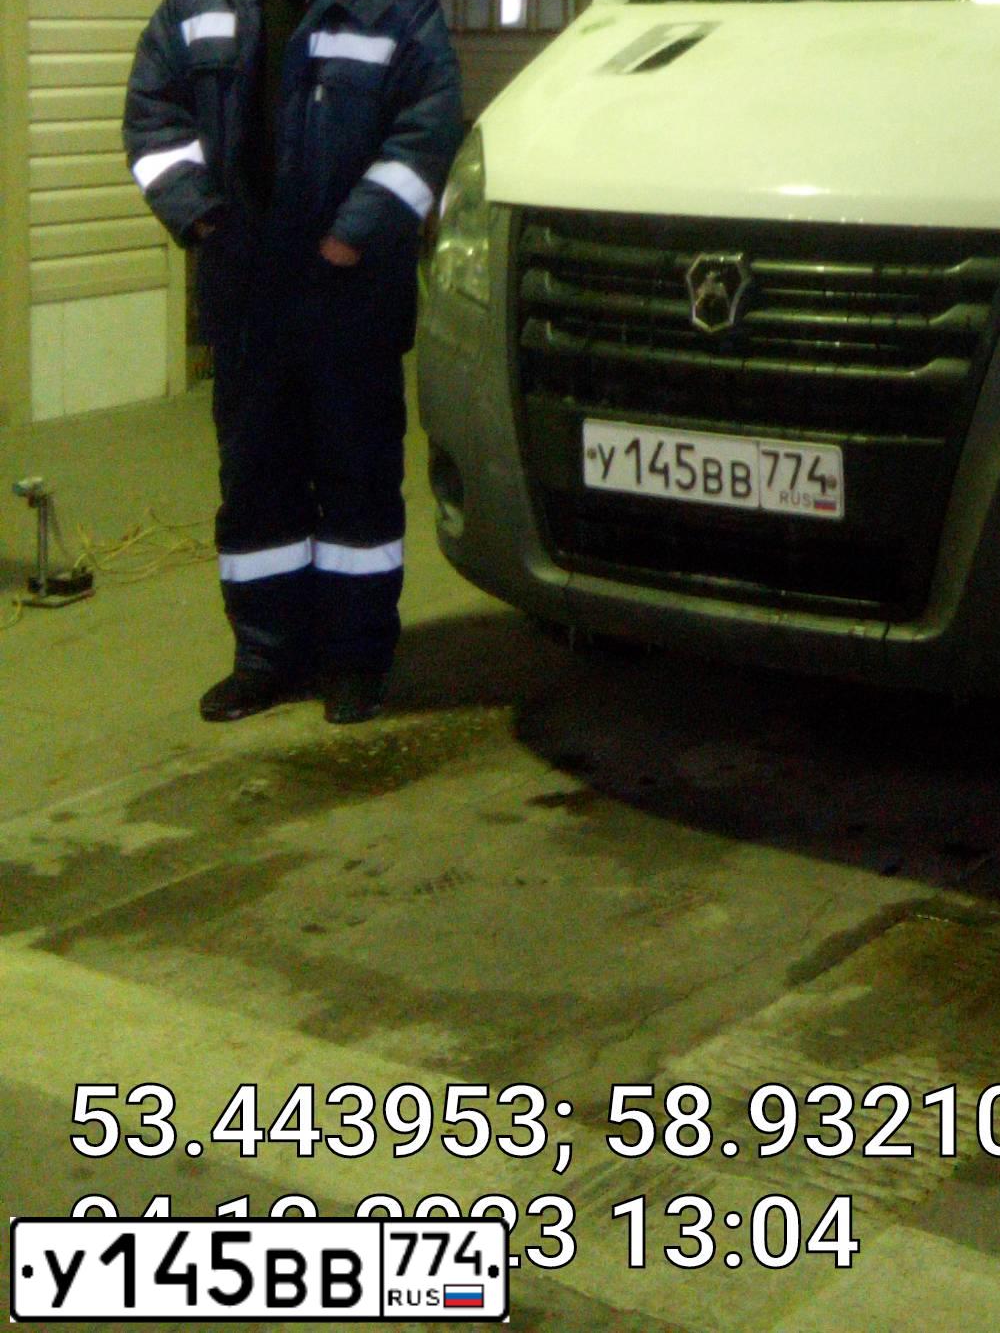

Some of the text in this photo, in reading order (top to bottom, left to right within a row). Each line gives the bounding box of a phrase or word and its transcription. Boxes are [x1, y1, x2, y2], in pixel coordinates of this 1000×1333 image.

[597, 437, 827, 498] У145ВВ 774
[779, 489, 812, 508] RUS
